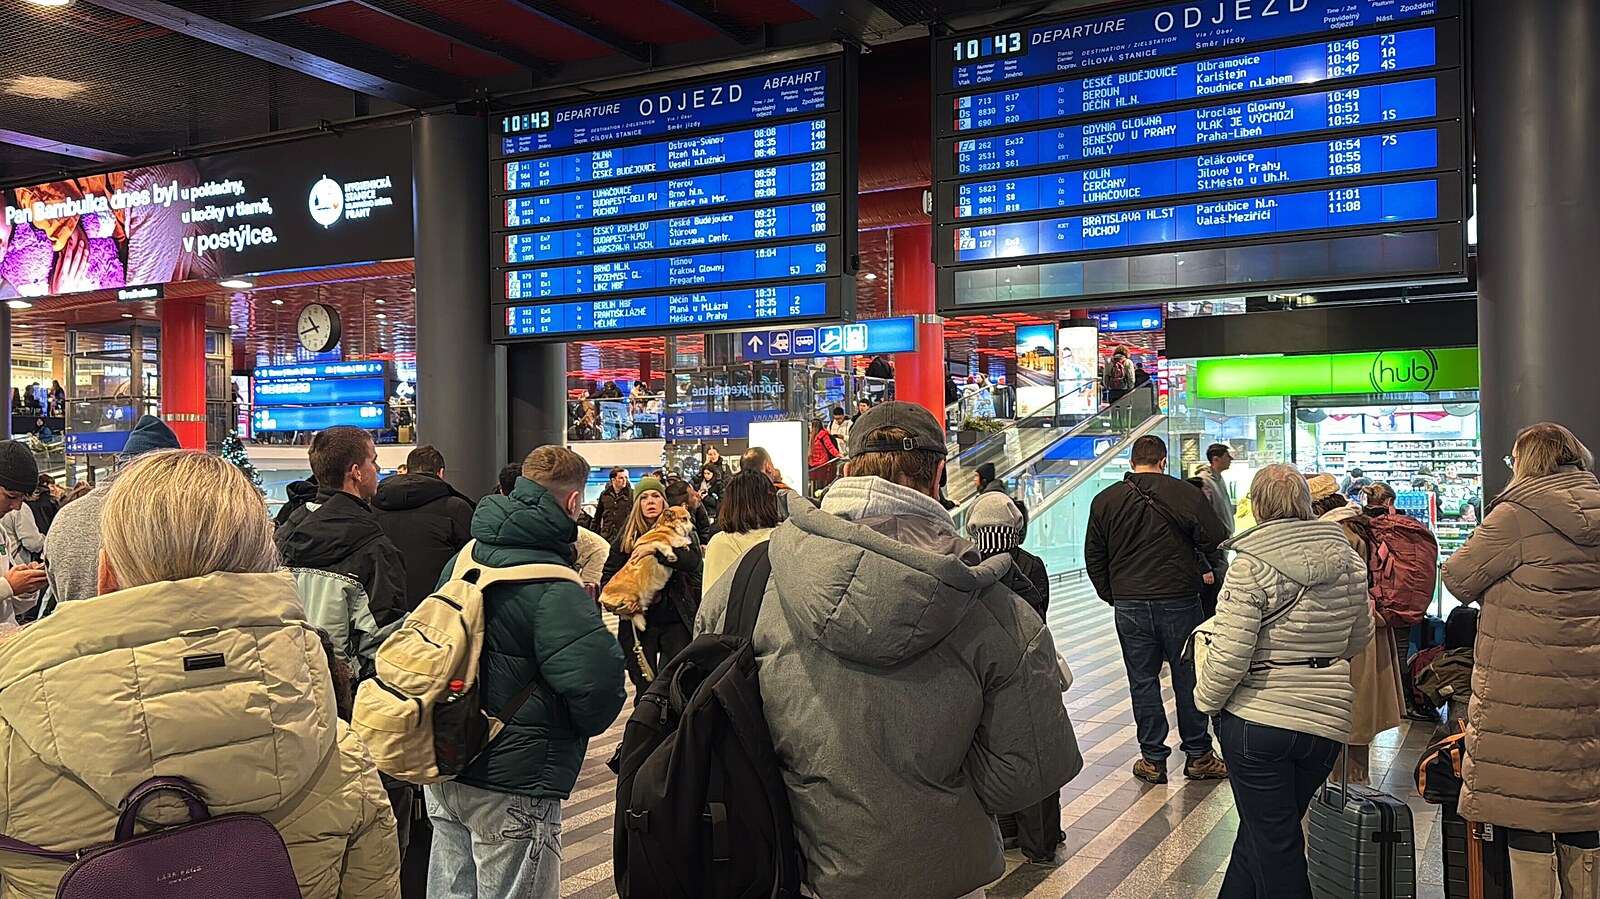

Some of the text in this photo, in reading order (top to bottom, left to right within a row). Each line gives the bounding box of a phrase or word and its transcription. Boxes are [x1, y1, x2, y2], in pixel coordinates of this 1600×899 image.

[1323, 13, 1360, 24] Pravidelný
[1330, 21, 1354, 29] odjezd
[1031, 18, 1127, 46] DEPARTURE
[1223, 35, 1246, 47] jízdy
[1380, 34, 1395, 46] 7J
[1327, 40, 1360, 53] 10:46
[1381, 47, 1396, 58] 1A
[1081, 49, 1157, 67] CÍLOVÁ STANICE
[1196, 55, 1260, 72] Olbramovice
[1327, 52, 1360, 65] 10:46
[1380, 59, 1396, 70] 4S
[1196, 69, 1247, 84] Karlštejn
[1327, 64, 1360, 78] 10:47
[763, 71, 822, 90] ABFAHRT
[1082, 66, 1178, 90] ČESKÉ BUDĚJOVICE
[1196, 74, 1293, 95] Roudnice n.Labem
[1005, 93, 1020, 101] R17
[1082, 87, 1120, 100] BEROUN
[1327, 90, 1360, 103] 10:49
[639, 84, 743, 116] ODJEZD
[978, 97, 992, 105] 713
[1082, 95, 1140, 112] DĚČÍN HL.N.
[556, 103, 621, 123] DEPARTURE
[1196, 101, 1285, 119] Wroclaw Glowny
[1327, 102, 1360, 115] 10:51
[1005, 115, 1020, 123] R20
[1196, 108, 1294, 130] VLAK JE VÝCHOZÍ
[1327, 113, 1360, 127] 10:52
[1381, 109, 1397, 121] 1S
[503, 111, 550, 133] 10:43
[811, 120, 825, 130] 160
[978, 118, 992, 127] 690
[1082, 116, 1162, 134] GDYNIA GLOWNA
[616, 129, 642, 139] STANICE
[754, 128, 776, 139] 08:08
[1082, 125, 1177, 146] BENEŠOV U PRAHY
[1196, 127, 1262, 143] Praha-Libeň
[668, 135, 724, 150] Ostrava-Svinov
[754, 137, 776, 148] 08:35
[978, 141, 992, 150] 262
[1005, 137, 1024, 146] Ex32
[1328, 139, 1361, 152] 10:54
[1381, 135, 1398, 146] 7S
[668, 151, 688, 160] Plzeň
[754, 148, 776, 158] 08:46
[978, 152, 996, 161] 2531
[1082, 145, 1113, 158] ÚVALY
[1328, 151, 1361, 164] 10:55
[592, 160, 609, 169] CHEB
[1005, 159, 1019, 168] S61
[1197, 152, 1255, 167] Čelákovice
[978, 161, 1001, 171] 28223
[1197, 161, 1281, 179] Jílové u Prahy
[1328, 163, 1361, 176] 10:58
[754, 169, 776, 179] 08:58
[1083, 167, 1110, 181] KOLÍN
[754, 178, 776, 188] 09:01
[1083, 178, 1126, 192] ČERČANY
[1197, 171, 1290, 190] St.Město u Uh.H.
[181, 178, 246, 201] u pokladny,
[668, 190, 686, 198] Brno
[754, 188, 776, 198] 09:08
[1083, 188, 1141, 203] LUHAČOVICE
[1328, 189, 1361, 202] 11:01
[5, 180, 179, 226] Pan Bambulka dnes byl
[668, 197, 708, 208] Hranice na
[1196, 198, 1278, 215] Pardubice hl.n.
[1328, 200, 1361, 214] 11:08
[181, 197, 273, 223] u kočky v tlamě,
[754, 208, 776, 218] 09:21
[754, 218, 776, 228] 09:37
[1082, 207, 1175, 227] BRATISLAVA HL.ST
[1196, 210, 1271, 226] Valaš.Meziříčí
[754, 228, 776, 238] 09:41
[1082, 225, 1121, 238] PÚCHOV
[183, 224, 278, 256] v postýlce.
[708, 233, 731, 243] Centr.
[755, 249, 776, 258] 10:04
[669, 257, 693, 266] Tišnov
[593, 264, 610, 273] BRNO
[669, 264, 724, 276] Krakow Glowny
[611, 281, 624, 290] HBF
[669, 275, 705, 286] Pregarten
[755, 288, 776, 298] 10:31
[594, 301, 615, 310] BERLIN
[755, 298, 776, 308] 10:35
[794, 296, 800, 304] 2
[706, 312, 728, 321] Prahy
[755, 308, 776, 318] 10:44
[1380, 358, 1430, 383] hub
